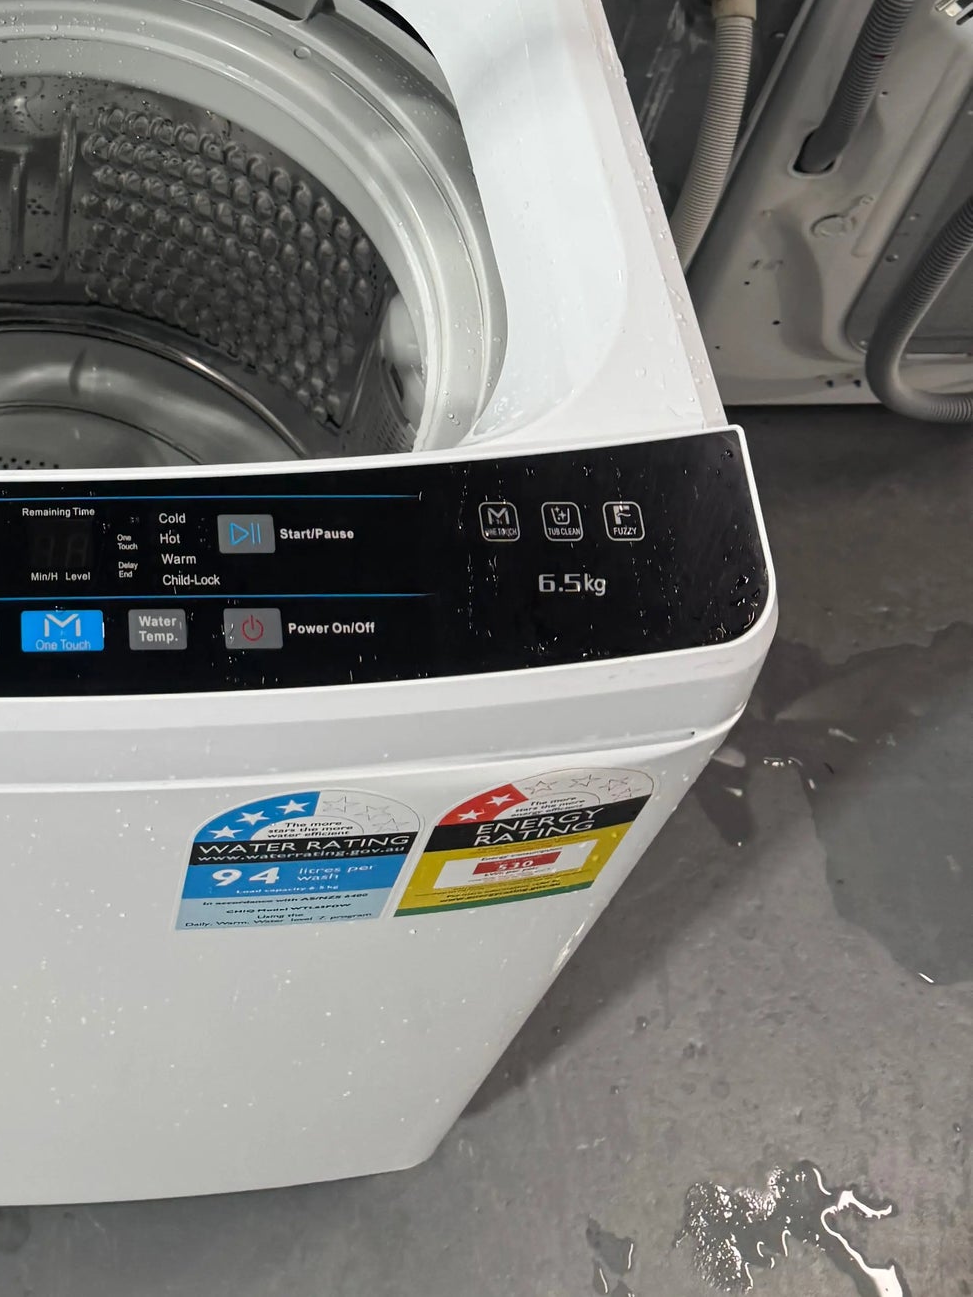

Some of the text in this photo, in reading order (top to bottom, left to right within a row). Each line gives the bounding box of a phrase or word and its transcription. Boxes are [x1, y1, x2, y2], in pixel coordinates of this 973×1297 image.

[22, 507, 95, 518] Remaining Time
[159, 513, 186, 524] Cold
[279, 527, 354, 540] Start/Pause
[548, 527, 581, 535] TUB CLEAN
[614, 527, 637, 535] FUZZY
[117, 534, 131, 542] One
[159, 534, 180, 544] Hot
[161, 554, 197, 564] Warm
[118, 561, 138, 570] Delay
[30, 572, 91, 582] Min/H Level
[118, 570, 133, 578] End
[163, 574, 220, 586] Child-Lock
[538, 573, 606, 596] 6.5kg
[138, 615, 176, 628] Water
[288, 621, 375, 635] Power On/Off
[139, 630, 178, 644] Temp.
[35, 639, 91, 651] One Touch
[477, 808, 604, 835] ENERGY
[474, 820, 595, 846] RATING
[199, 836, 410, 853] WATER RATING
[198, 846, 405, 861] www.waterrating.gov.au
[212, 867, 280, 887] 94
[347, 865, 375, 873] per
[297, 874, 339, 882] wash
